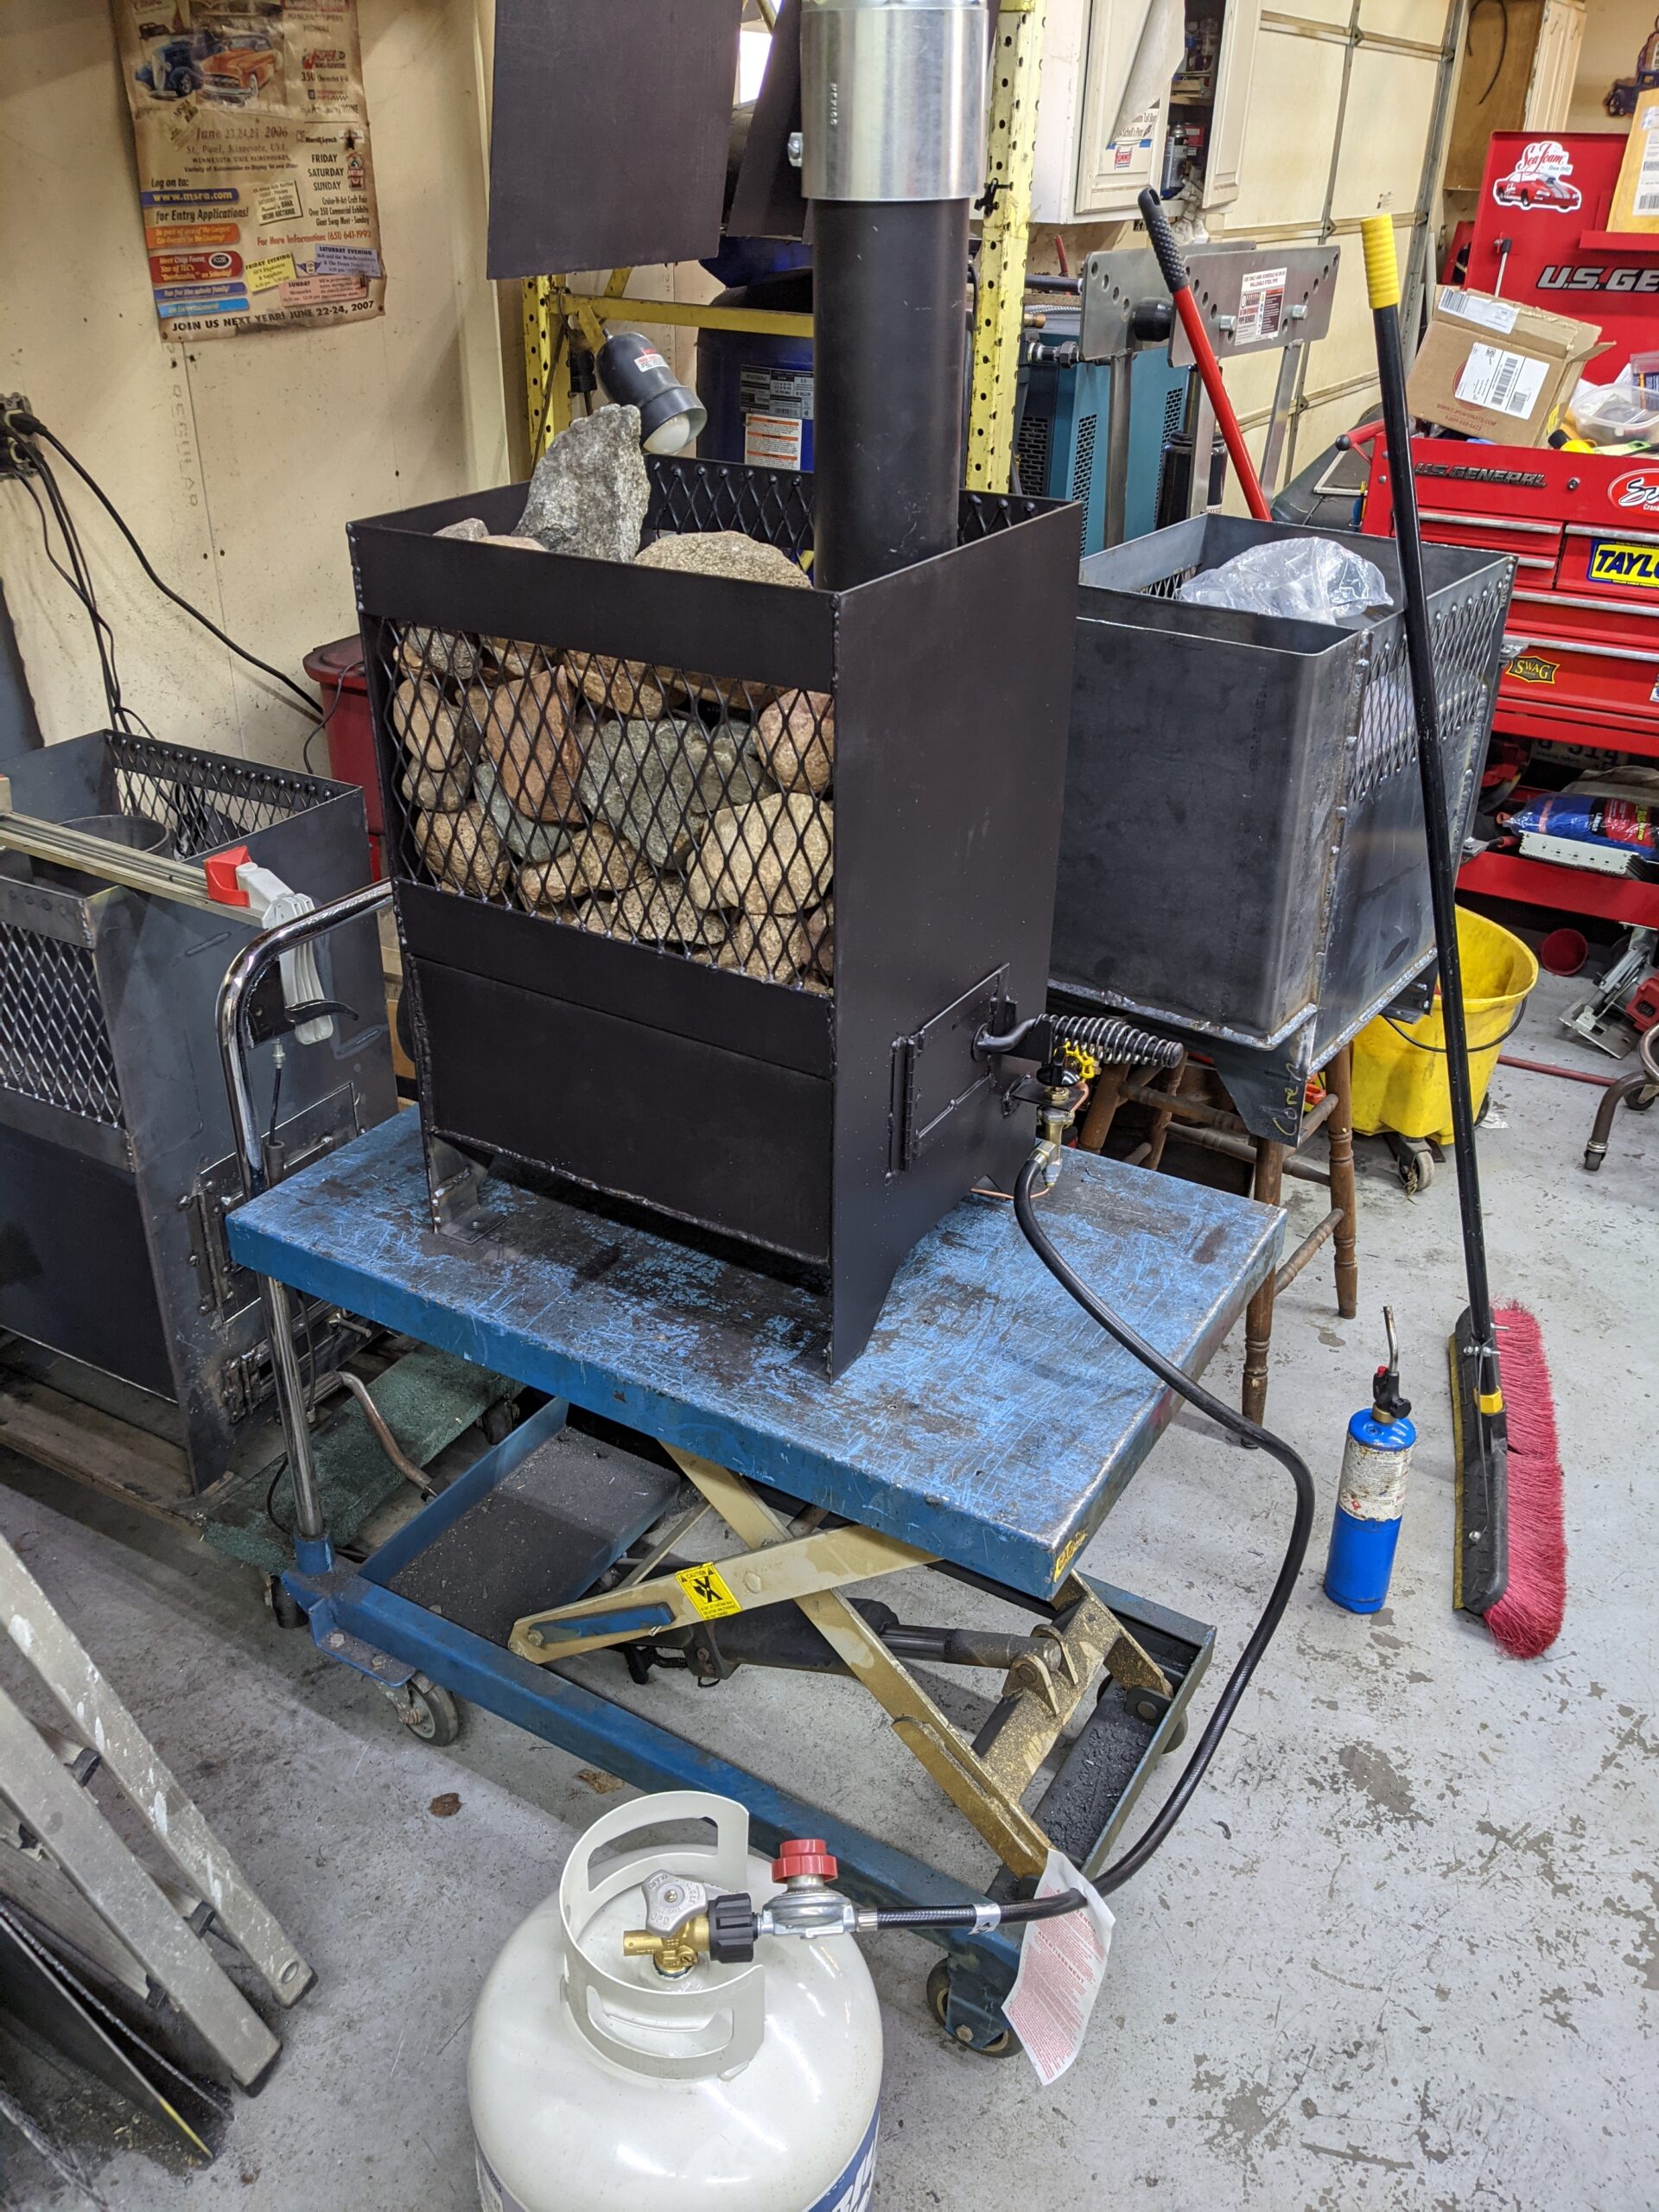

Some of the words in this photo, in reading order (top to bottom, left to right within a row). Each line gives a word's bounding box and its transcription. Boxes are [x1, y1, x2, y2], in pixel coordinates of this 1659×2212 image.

[311, 154, 339, 163] FRIDAY
[1517, 144, 1539, 170] Sea
[307, 168, 344, 178] SATURDAY
[150, 178, 164, 189] Log
[178, 177, 189, 187] to:
[313, 181, 341, 192] SUNDAY
[153, 191, 233, 202] www.msra.com
[156, 210, 169, 225] for
[171, 209, 195, 222] Entry
[197, 207, 249, 222] Applications!
[257, 236, 269, 245] For
[270, 235, 285, 245] More
[346, 247, 373, 257] EVENING
[266, 253, 291, 265] EVENING
[172, 321, 201, 332] JOIN
[206, 319, 220, 329] US
[224, 315, 251, 328] NEXT
[254, 312, 286, 323] YEAR!
[289, 308, 314, 321] JUNE
[316, 305, 348, 317] 22-24,
[351, 300, 374, 312] 2007
[1515, 659, 1550, 679] SWAG
[685, 1570, 707, 1580] CAUTION
[1038, 1931, 1085, 1984] AVERTISSEMENT
